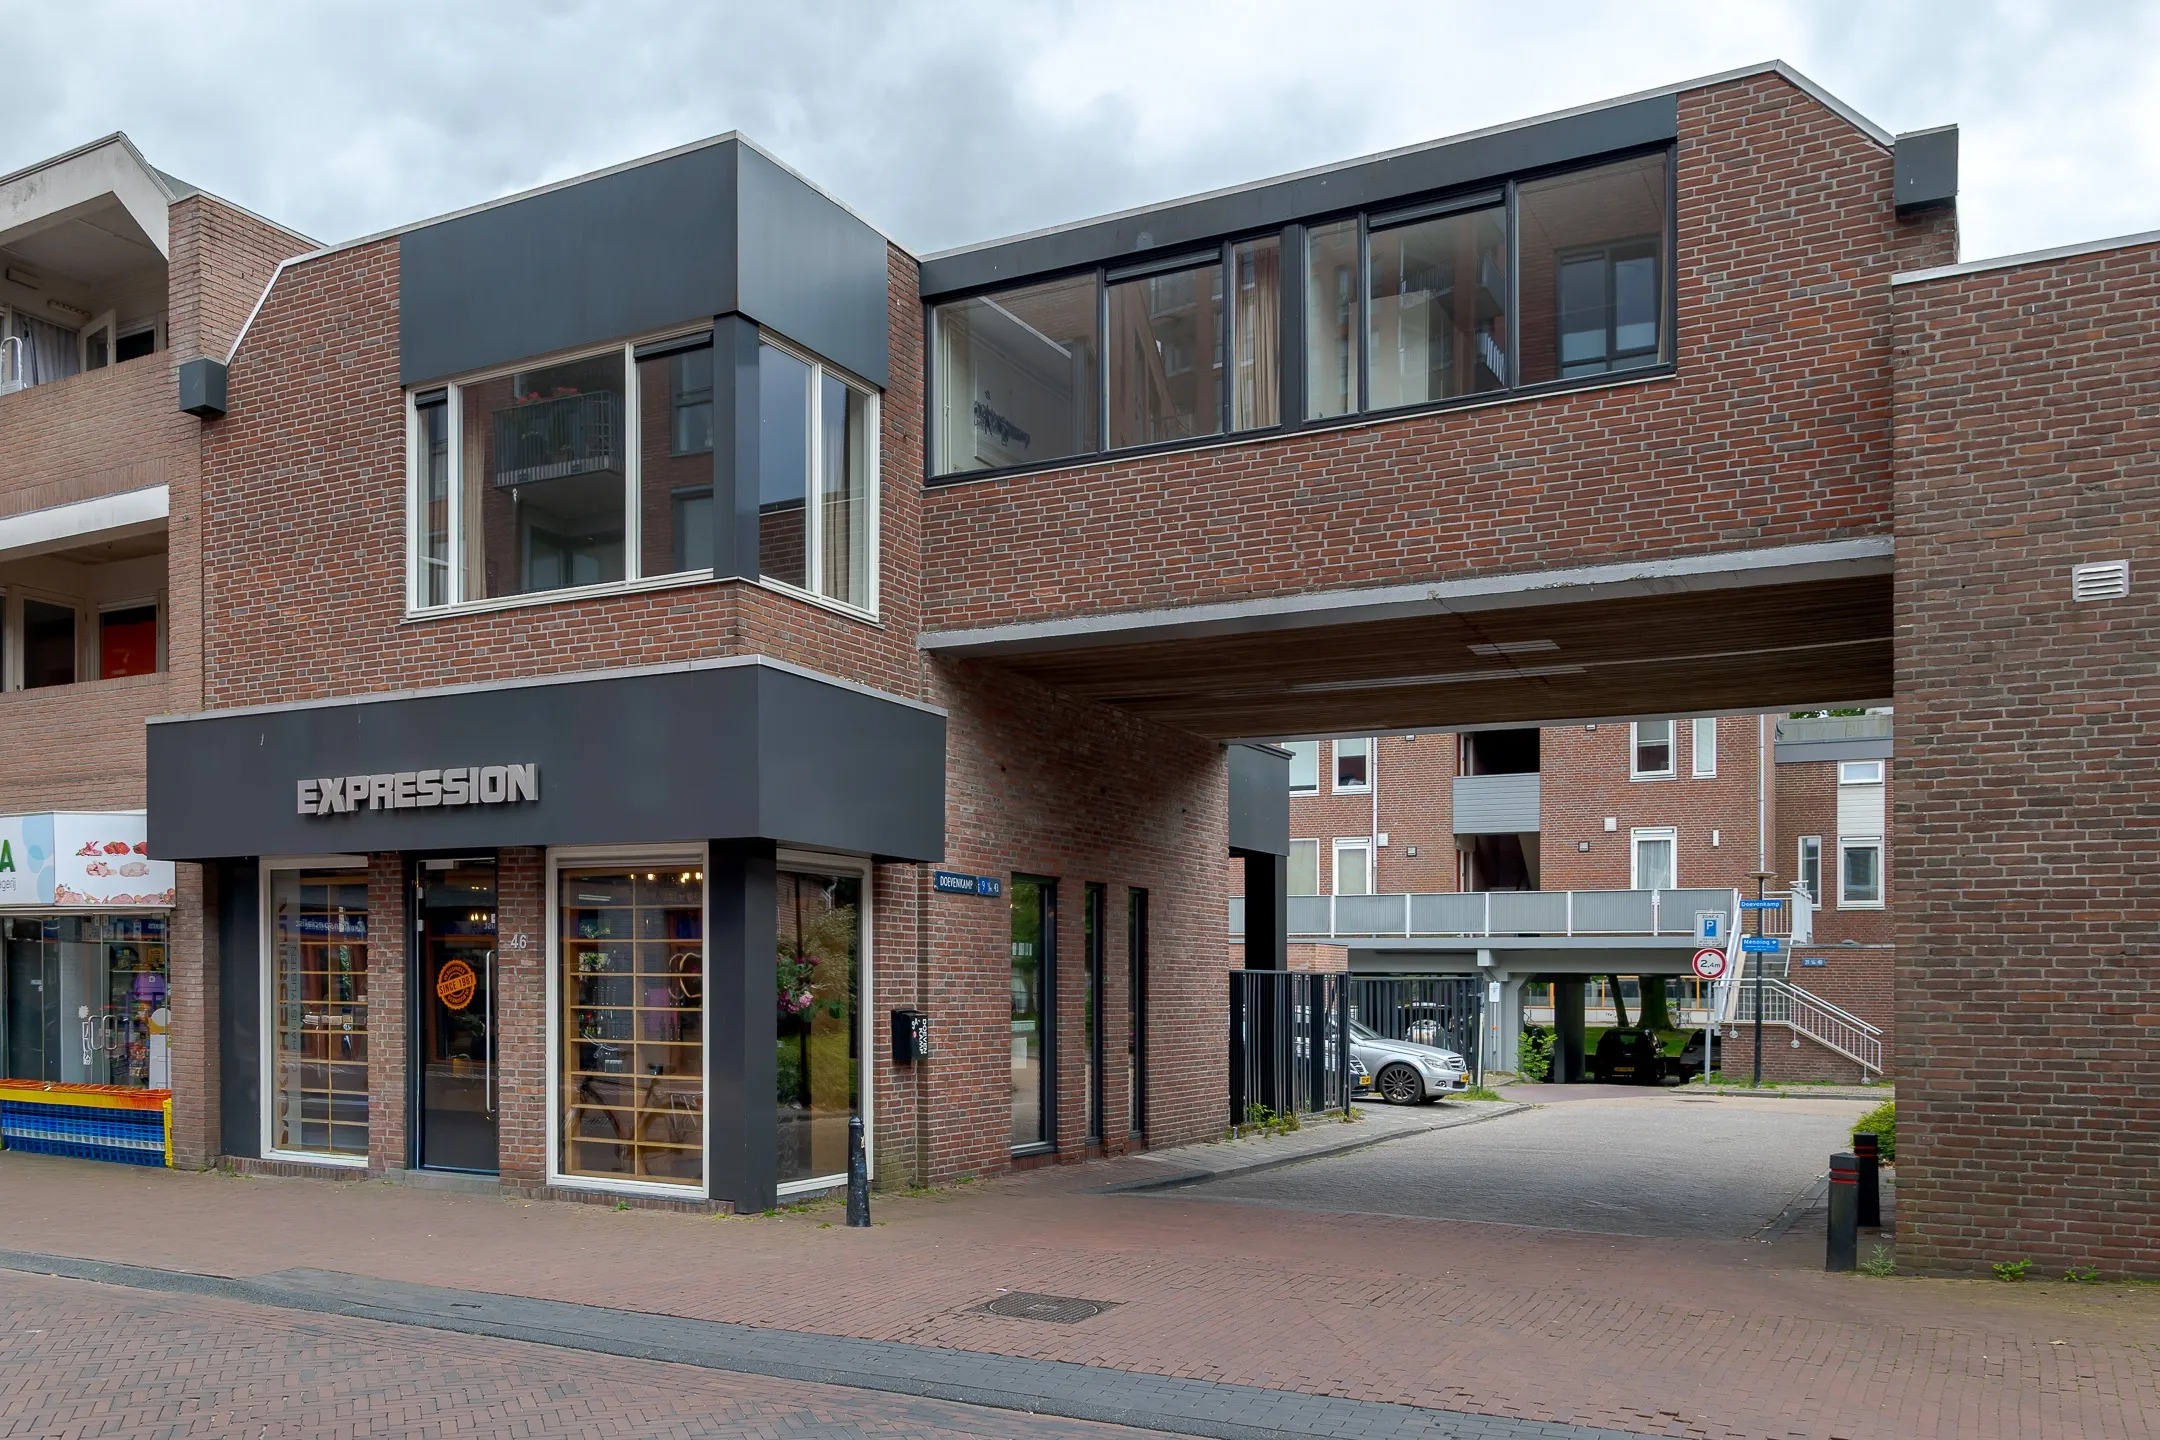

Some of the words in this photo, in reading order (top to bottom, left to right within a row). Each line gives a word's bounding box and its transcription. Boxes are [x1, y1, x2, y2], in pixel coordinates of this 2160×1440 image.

[297, 763, 538, 815] EXPRESSION
[940, 875, 974, 889] DOEVENKAMP
[981, 880, 986, 890] 9
[1706, 920, 1714, 930] P
[511, 934, 527, 949] 46
[439, 981, 457, 995] SINCE
[459, 975, 474, 988] 1987
